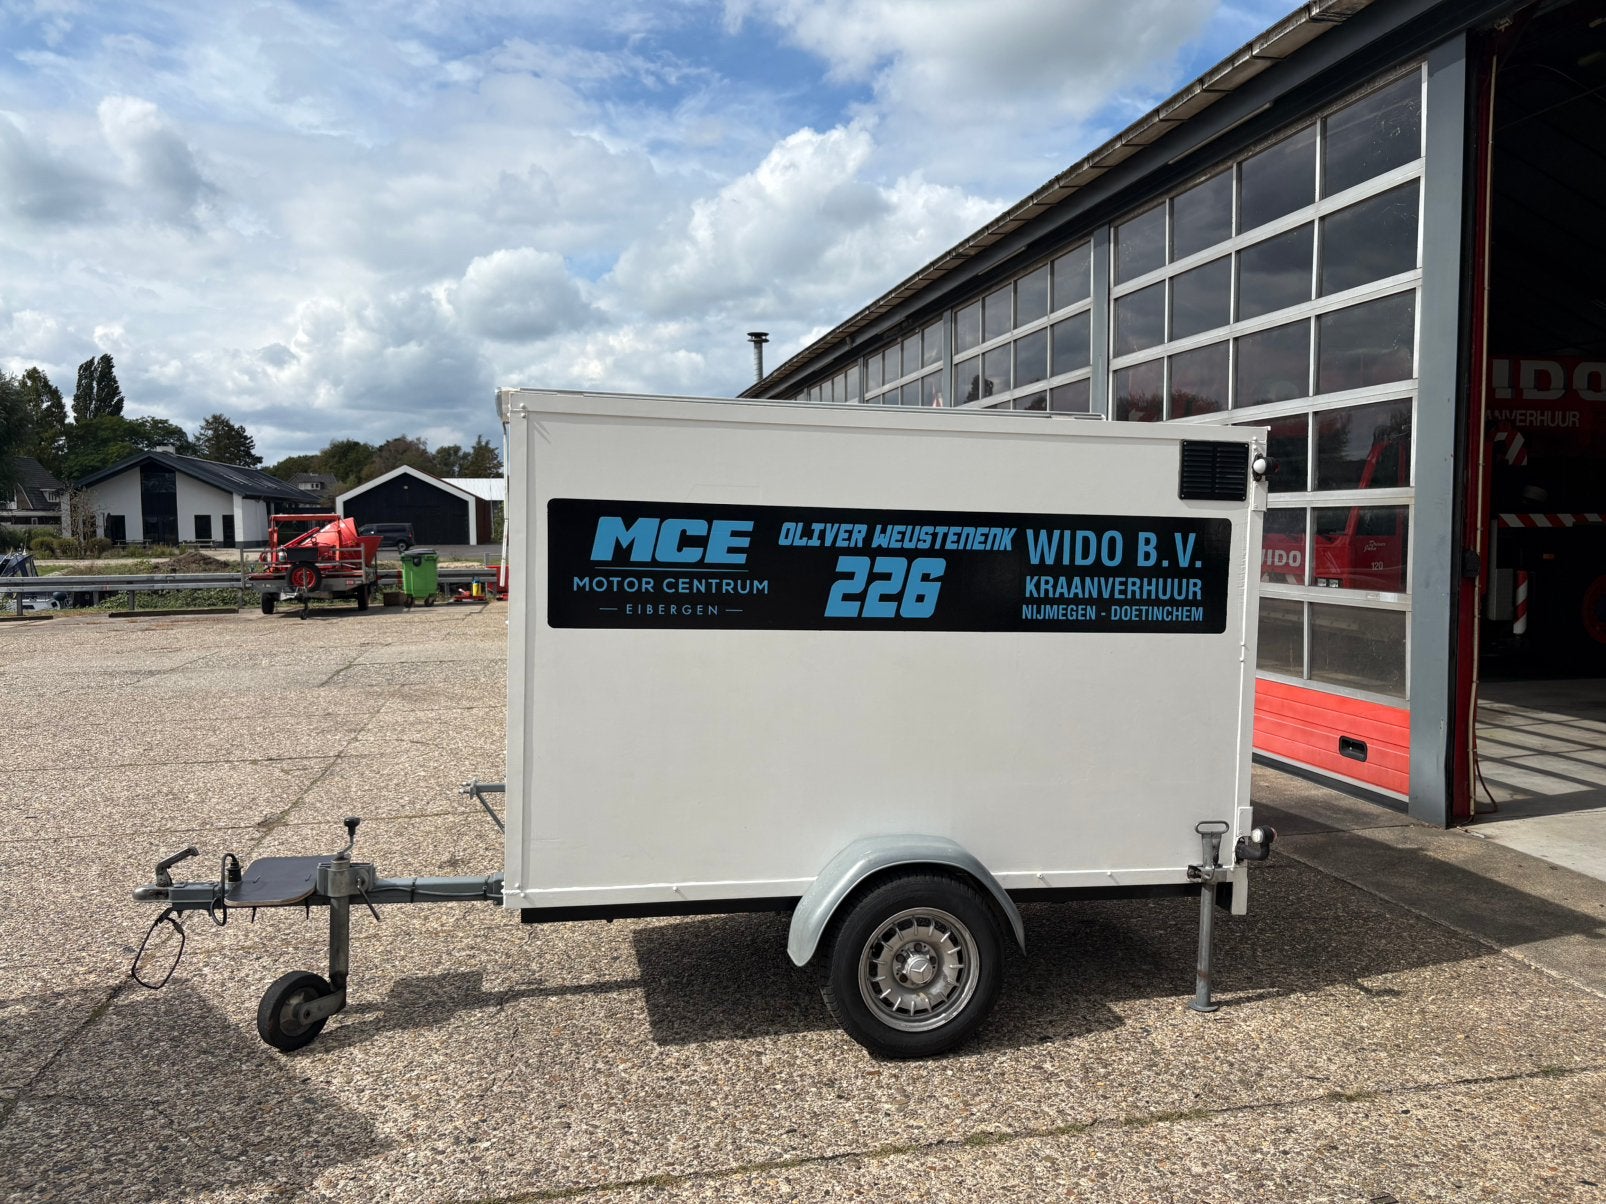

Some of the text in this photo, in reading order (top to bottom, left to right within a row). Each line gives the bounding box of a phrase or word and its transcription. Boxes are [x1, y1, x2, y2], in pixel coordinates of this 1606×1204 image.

[590, 516, 755, 564] MCE
[778, 521, 1018, 551] OLIVER WEUSTENENK
[1026, 528, 1202, 568] WIDO B.V.
[573, 576, 769, 595] MOTOR CENTRUM
[824, 555, 947, 619] 226
[1025, 575, 1202, 601] KRAANVERHUUR
[626, 603, 718, 616] EIBERGEN
[1022, 604, 1096, 620] NIJMEGEN
[1111, 606, 1203, 622] DOETINCHEM
